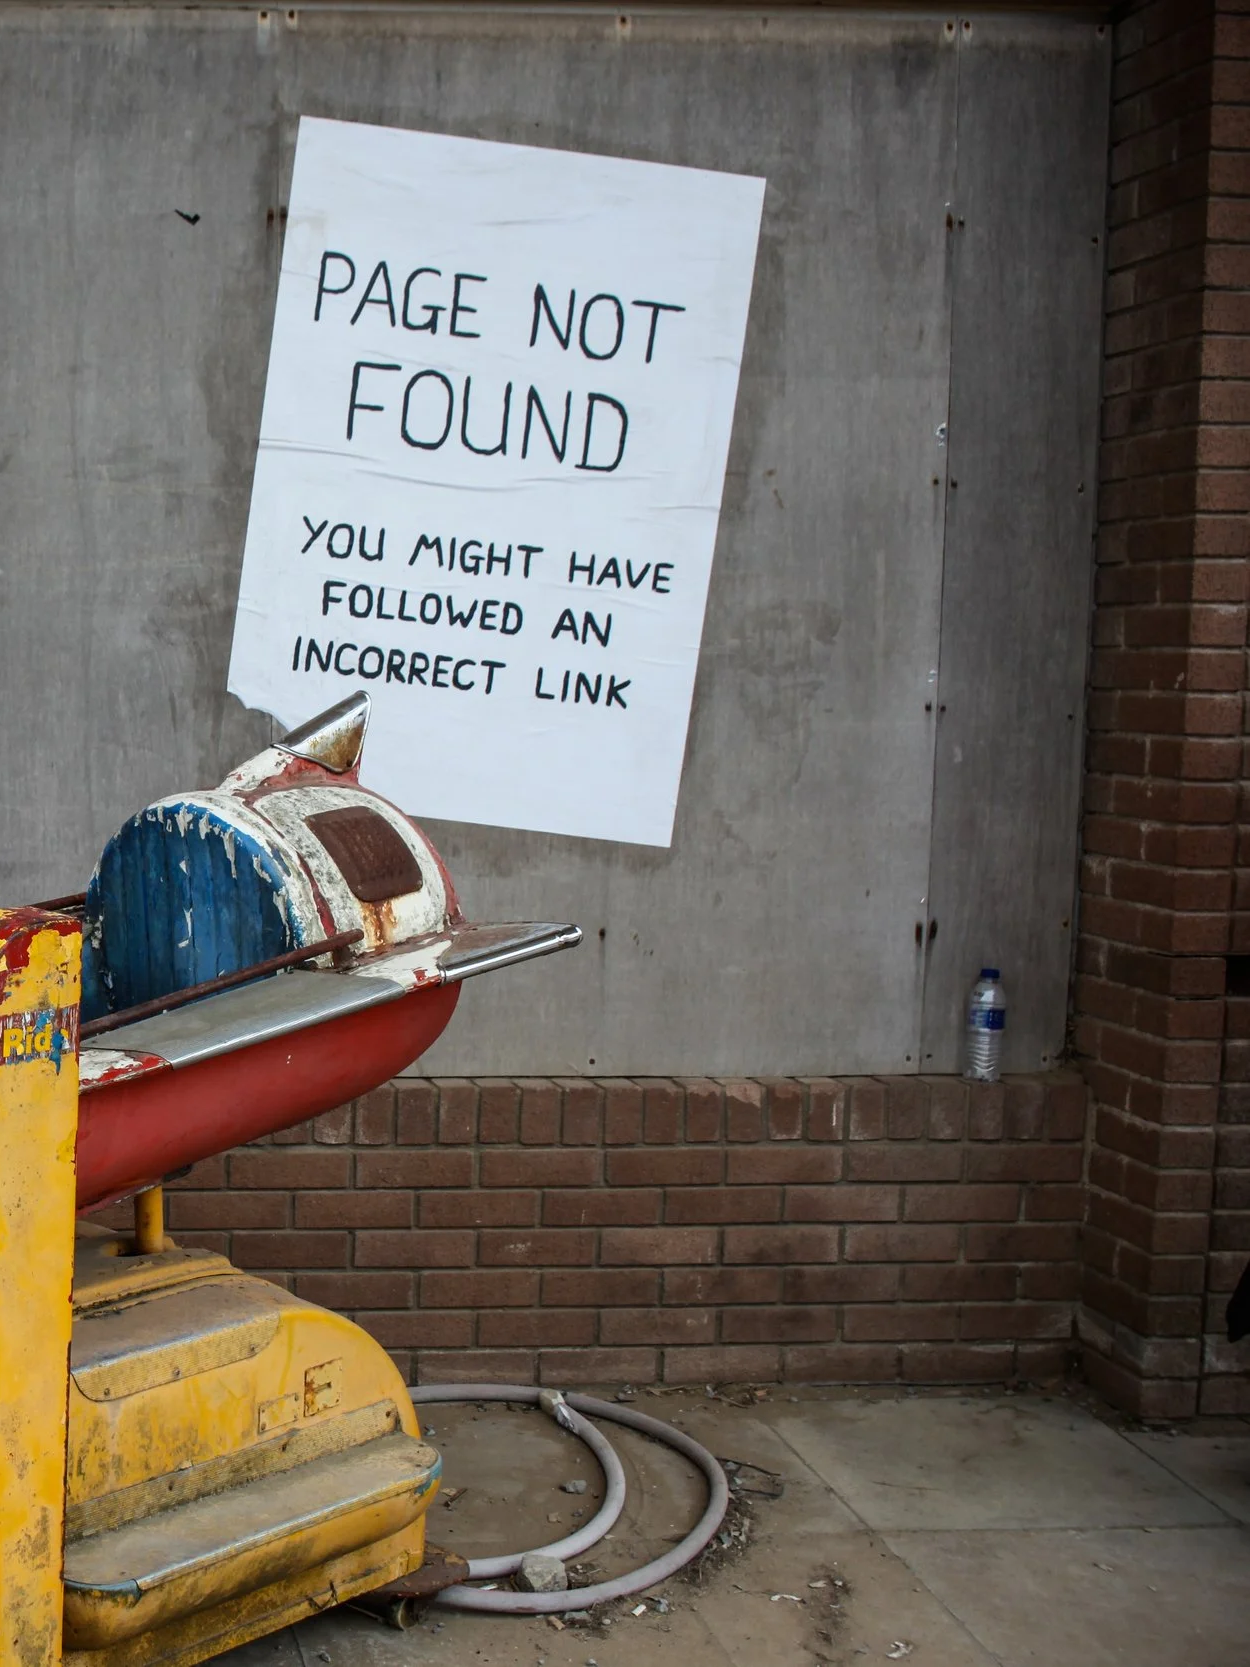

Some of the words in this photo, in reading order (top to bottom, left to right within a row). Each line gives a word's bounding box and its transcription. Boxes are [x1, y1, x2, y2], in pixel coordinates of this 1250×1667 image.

[314, 251, 487, 338] PAGE
[529, 284, 686, 364] NOT
[346, 361, 629, 473] FOUND
[301, 516, 385, 562] YOU
[408, 534, 544, 579] MIGHT
[568, 551, 674, 594] HAVE
[322, 580, 523, 635] FOLLOWED
[551, 608, 612, 647] AN
[292, 636, 506, 695] INCORRECT
[535, 667, 631, 709] LINK
